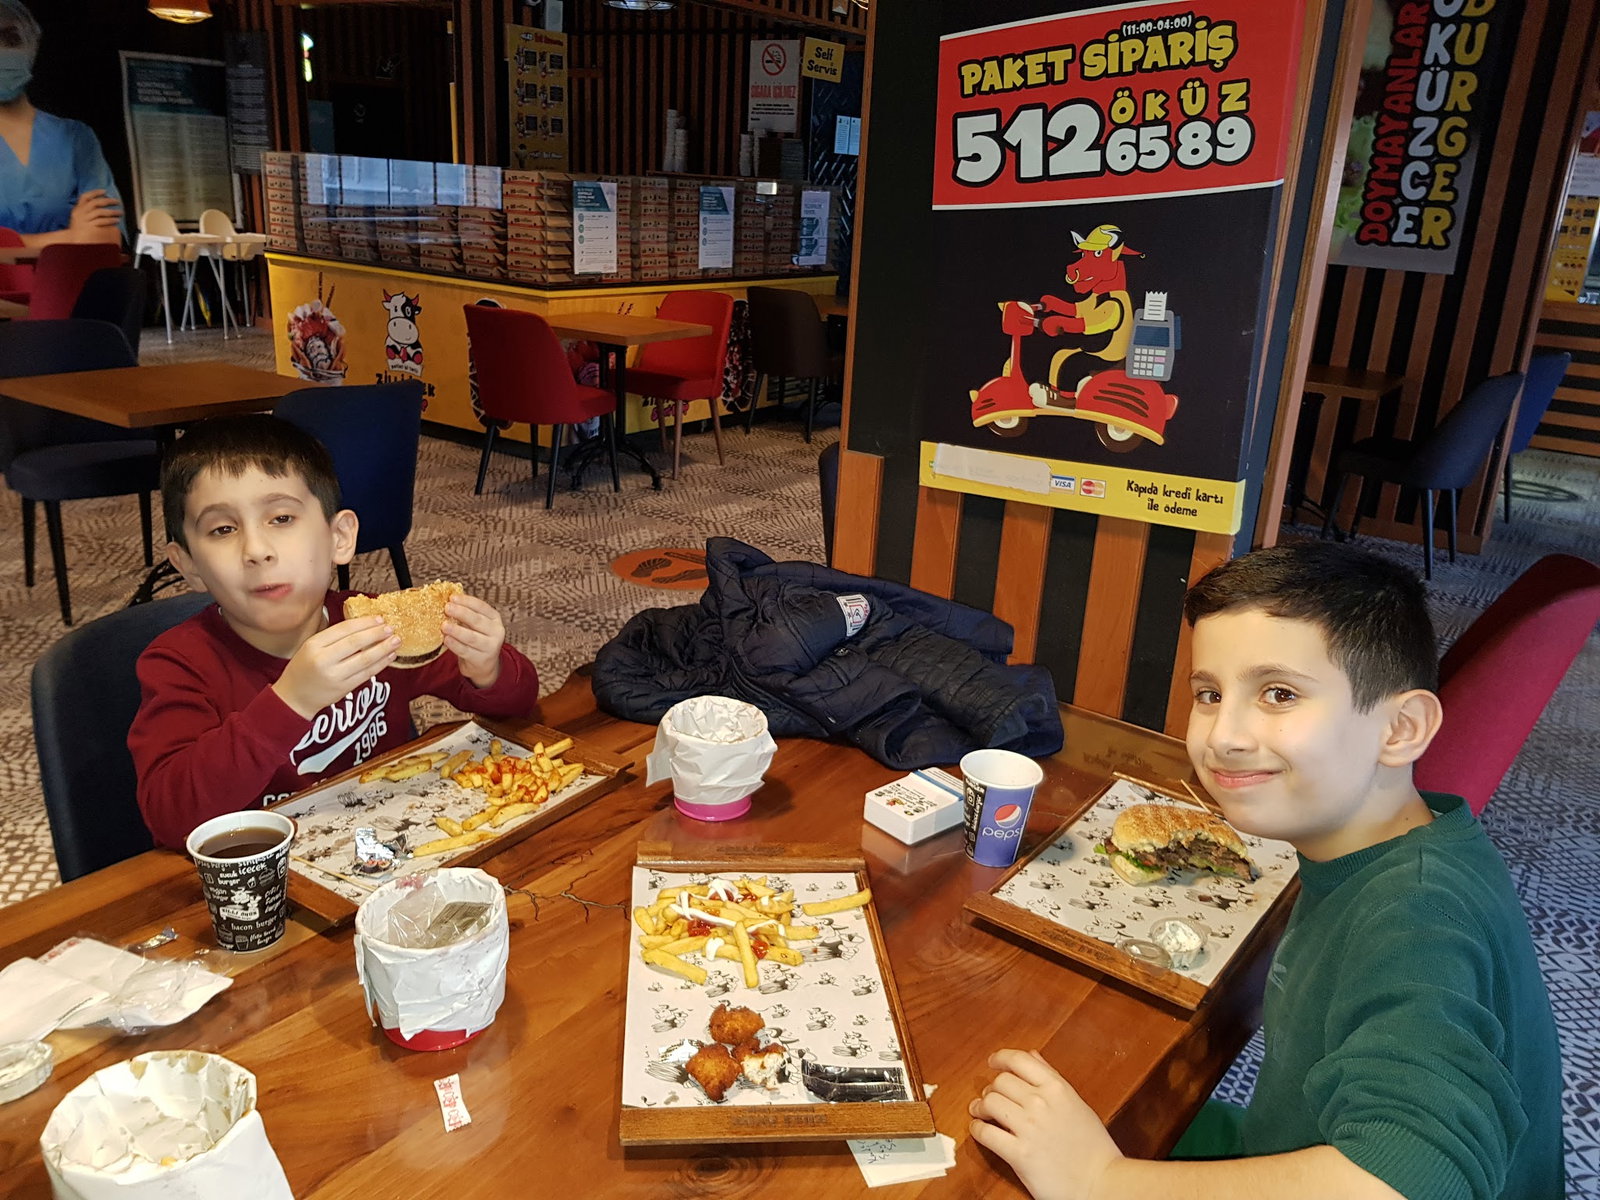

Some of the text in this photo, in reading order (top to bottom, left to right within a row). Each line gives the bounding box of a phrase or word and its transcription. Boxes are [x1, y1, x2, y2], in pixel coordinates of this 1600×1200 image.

[1122, 14, 1192, 36] (11:00-04:00)
[815, 47, 834, 61] Self
[960, 21, 1235, 95] PAKET SİPARİŞ
[807, 60, 838, 76] Servis
[1054, 480, 1072, 489] VISA
[1126, 479, 1224, 504] Kapıda kredi kartı
[1147, 497, 1198, 517] ile ödeme
[353, 711, 388, 766] 1986
[231, 923, 253, 931] bacon
[256, 915, 278, 929] burger
